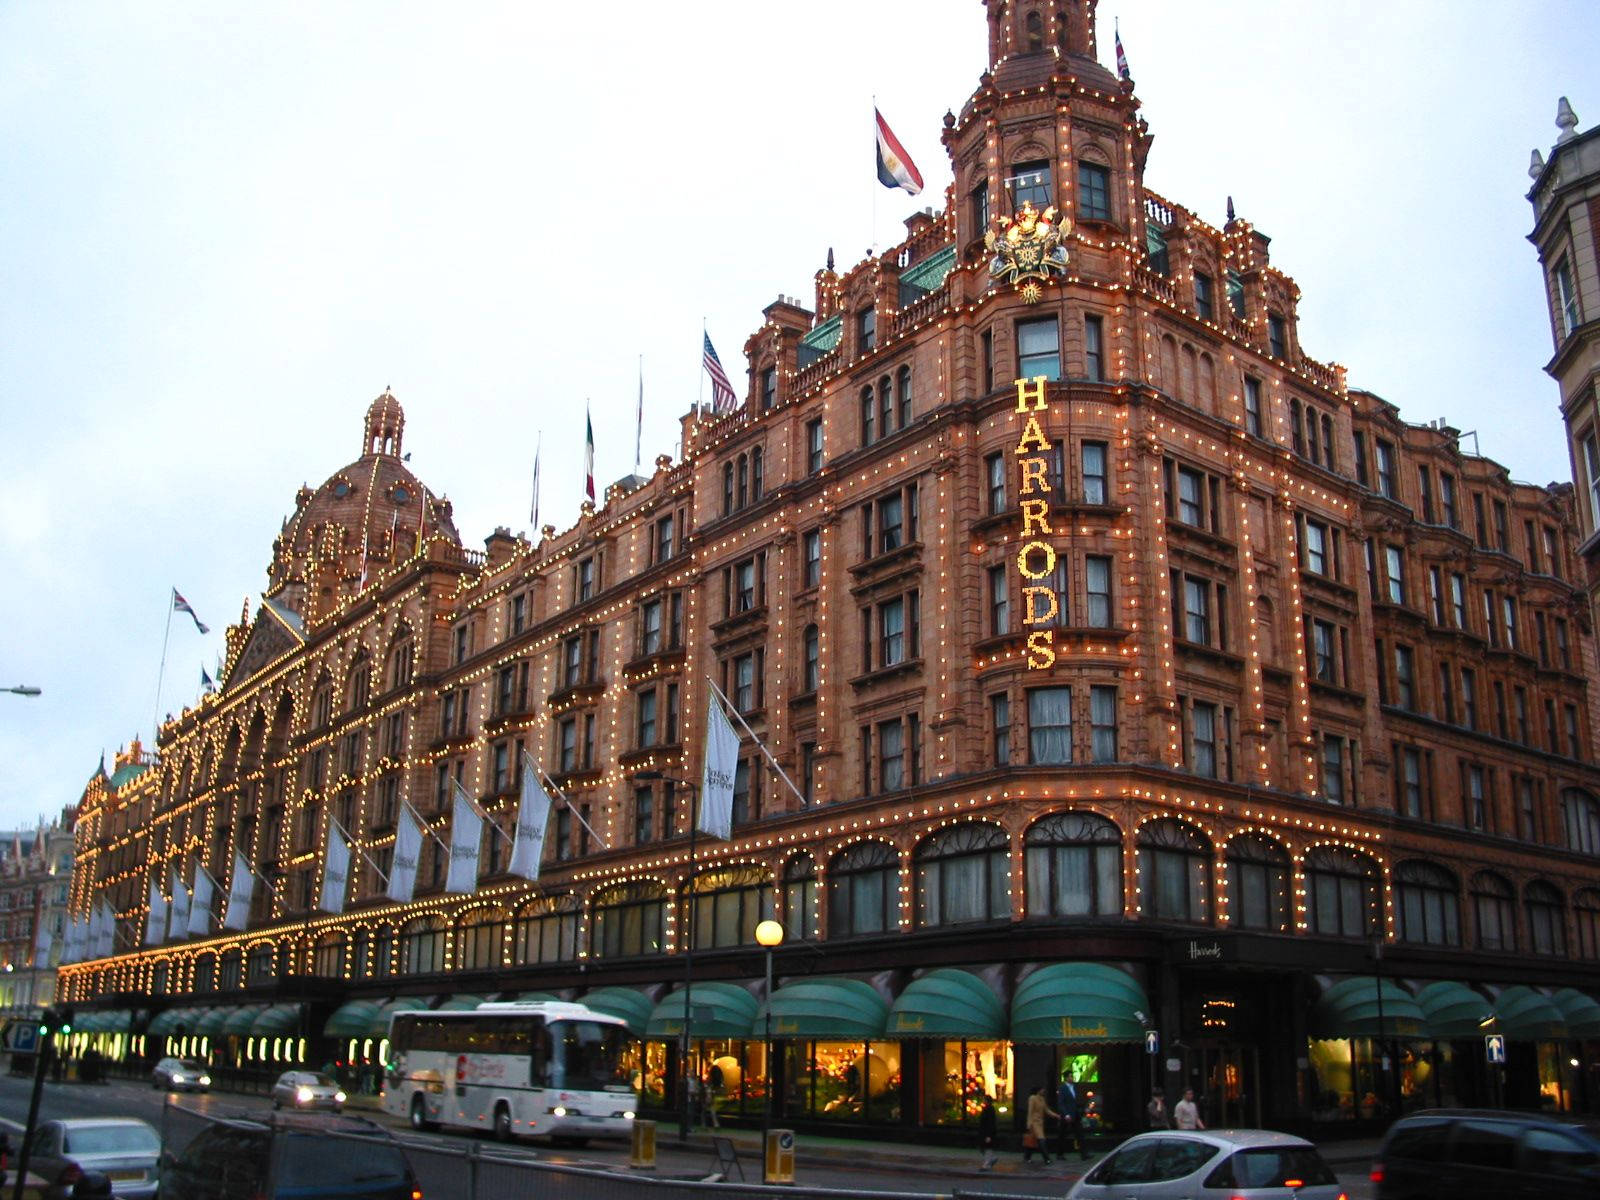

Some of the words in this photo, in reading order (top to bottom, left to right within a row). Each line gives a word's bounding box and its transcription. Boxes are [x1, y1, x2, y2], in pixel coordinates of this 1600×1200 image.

[1014, 375, 1057, 671] HARRODS
[1188, 941, 1221, 959] Harrods
[18, 1026, 32, 1046] P
